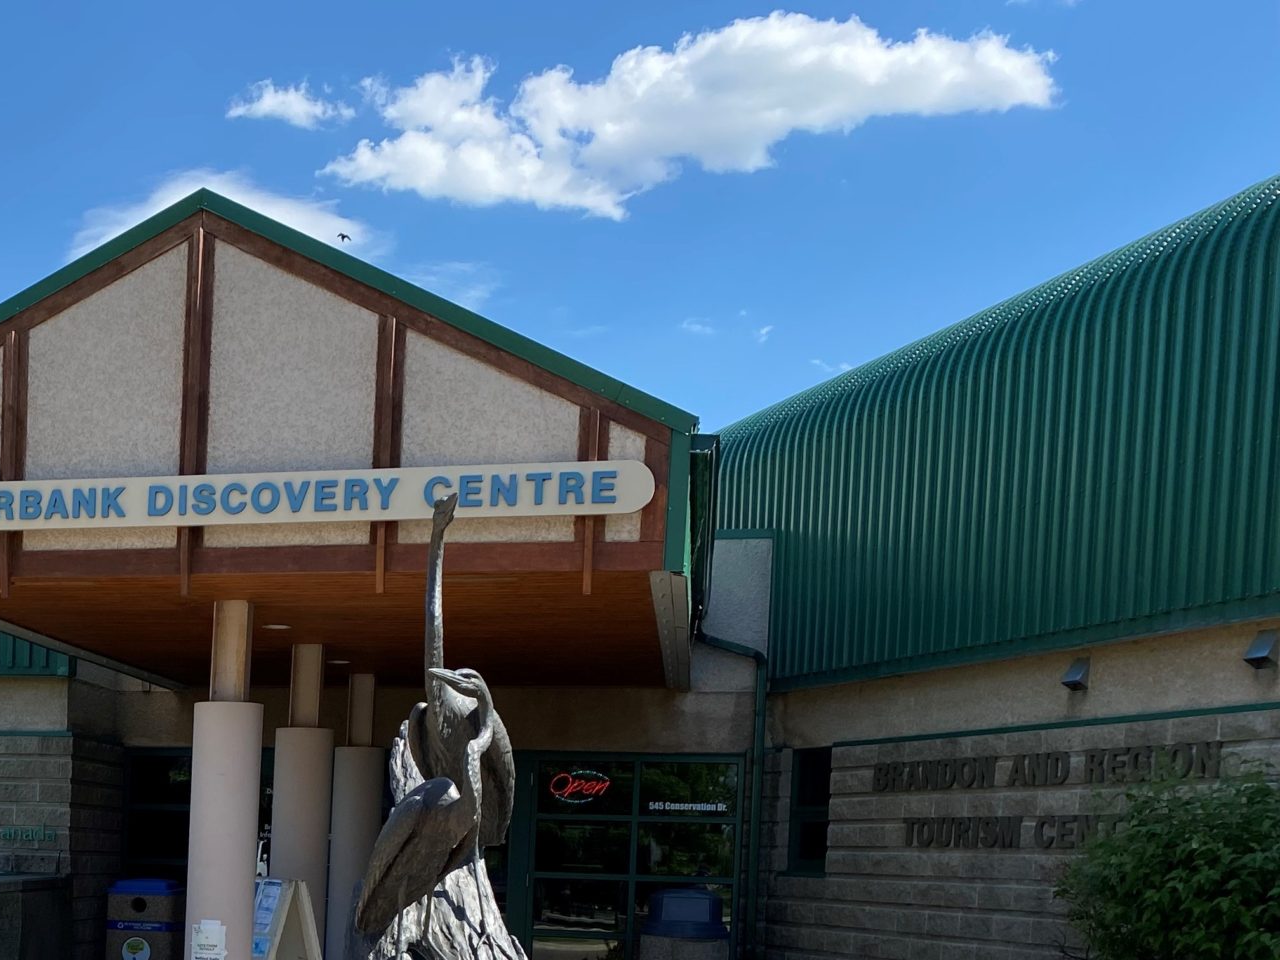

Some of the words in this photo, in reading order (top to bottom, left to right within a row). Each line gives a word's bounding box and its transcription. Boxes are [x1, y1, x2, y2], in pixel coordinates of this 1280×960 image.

[148, 477, 400, 516] DISCOVERY
[424, 471, 617, 510] CENTRE
[549, 772, 611, 797] Open
[872, 756, 996, 791] BRANDON
[1009, 751, 1069, 786] AND
[649, 802, 664, 811] 545
[665, 802, 716, 811] Conservation
[717, 802, 728, 811] Dr.
[903, 816, 1023, 849] TOURISM
